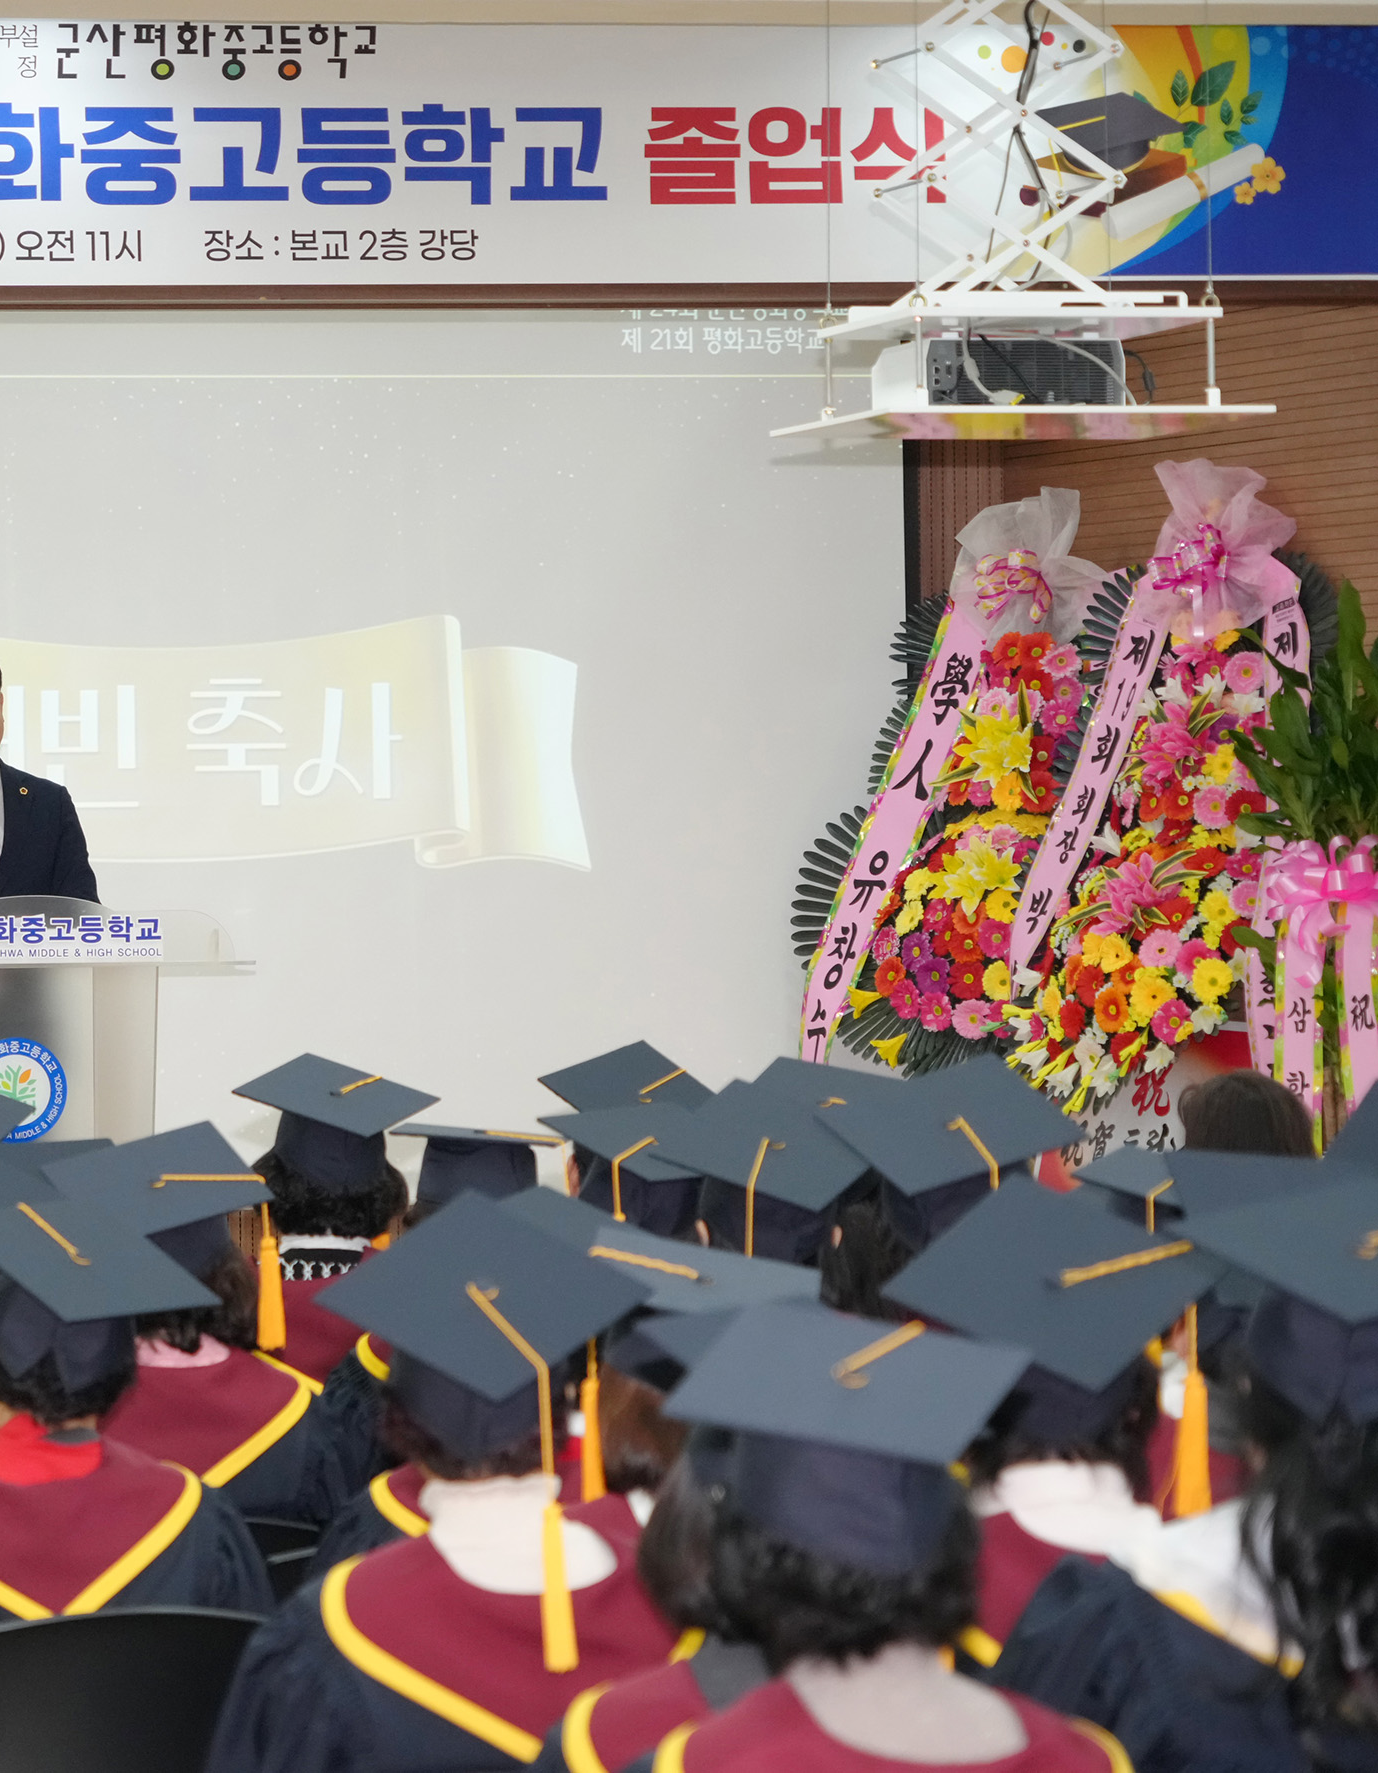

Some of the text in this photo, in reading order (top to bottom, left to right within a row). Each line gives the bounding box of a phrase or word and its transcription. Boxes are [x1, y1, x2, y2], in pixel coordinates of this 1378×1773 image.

[0, 24, 38, 48] 부설
[56, 21, 377, 81] 군산평화중고등학교
[644, 106, 947, 205] 졸업식
[15, 230, 75, 262] 오전
[86, 229, 142, 262] 11시
[205, 229, 264, 262] 장소
[290, 229, 350, 261] 본교
[359, 229, 409, 262] 2층
[420, 229, 479, 261] 강당
[621, 326, 825, 355] 제 21회 평화고등학교
[186, 678, 404, 806] 축사
[28, 948, 69, 958] MIDDLE
[74, 948, 81, 957] &
[86, 948, 113, 957] HIGH
[118, 947, 162, 957] SCHOOL
[45, 1104, 60, 1123] HIGH
[53, 1073, 64, 1105] SCHOOL
